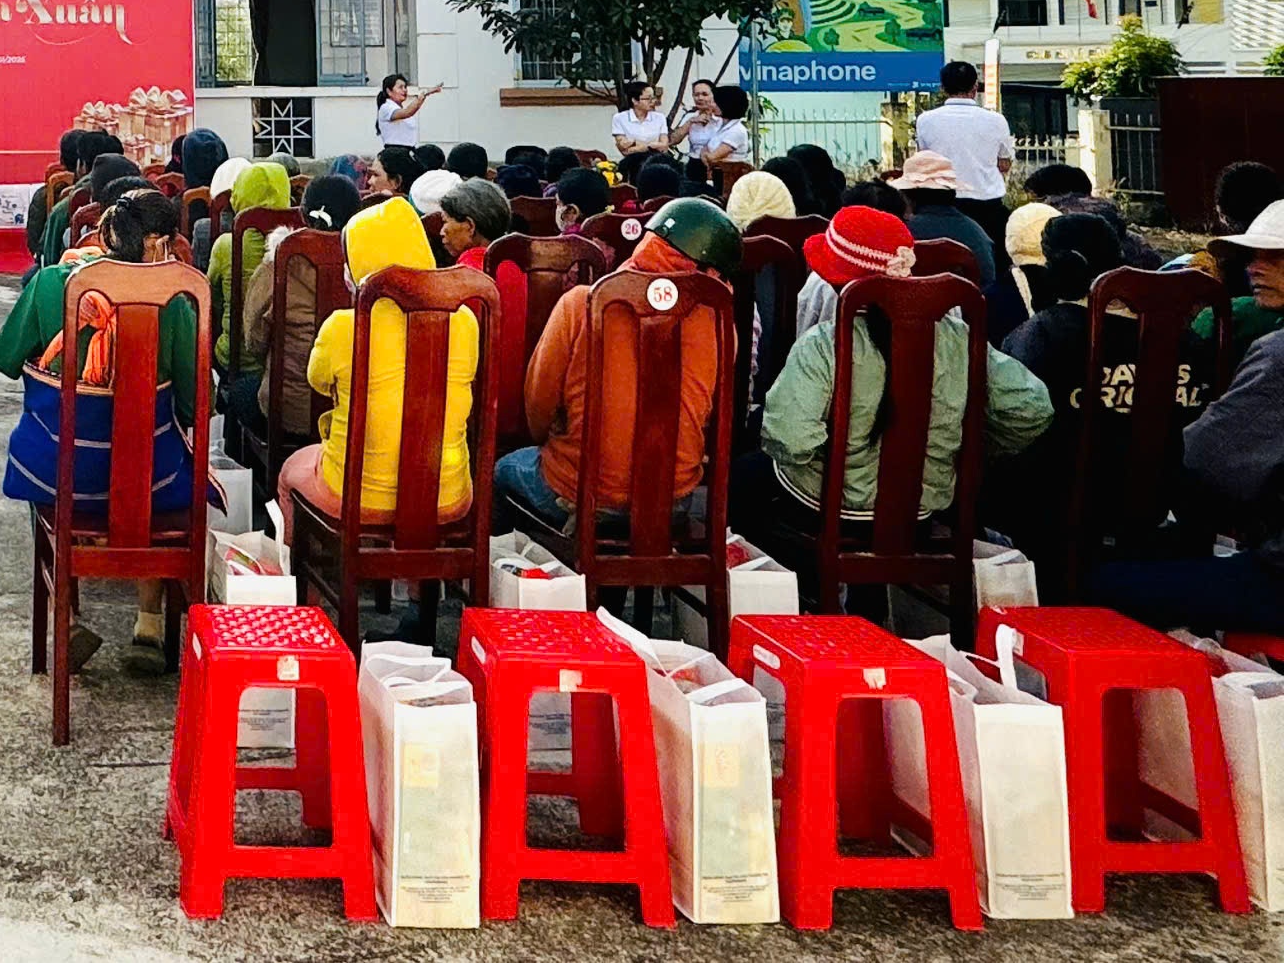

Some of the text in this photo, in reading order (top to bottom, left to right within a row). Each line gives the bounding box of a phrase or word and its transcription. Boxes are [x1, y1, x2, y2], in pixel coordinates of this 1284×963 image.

[739, 60, 876, 84] vinaphone
[625, 223, 639, 235] 26
[653, 285, 673, 303] 58
